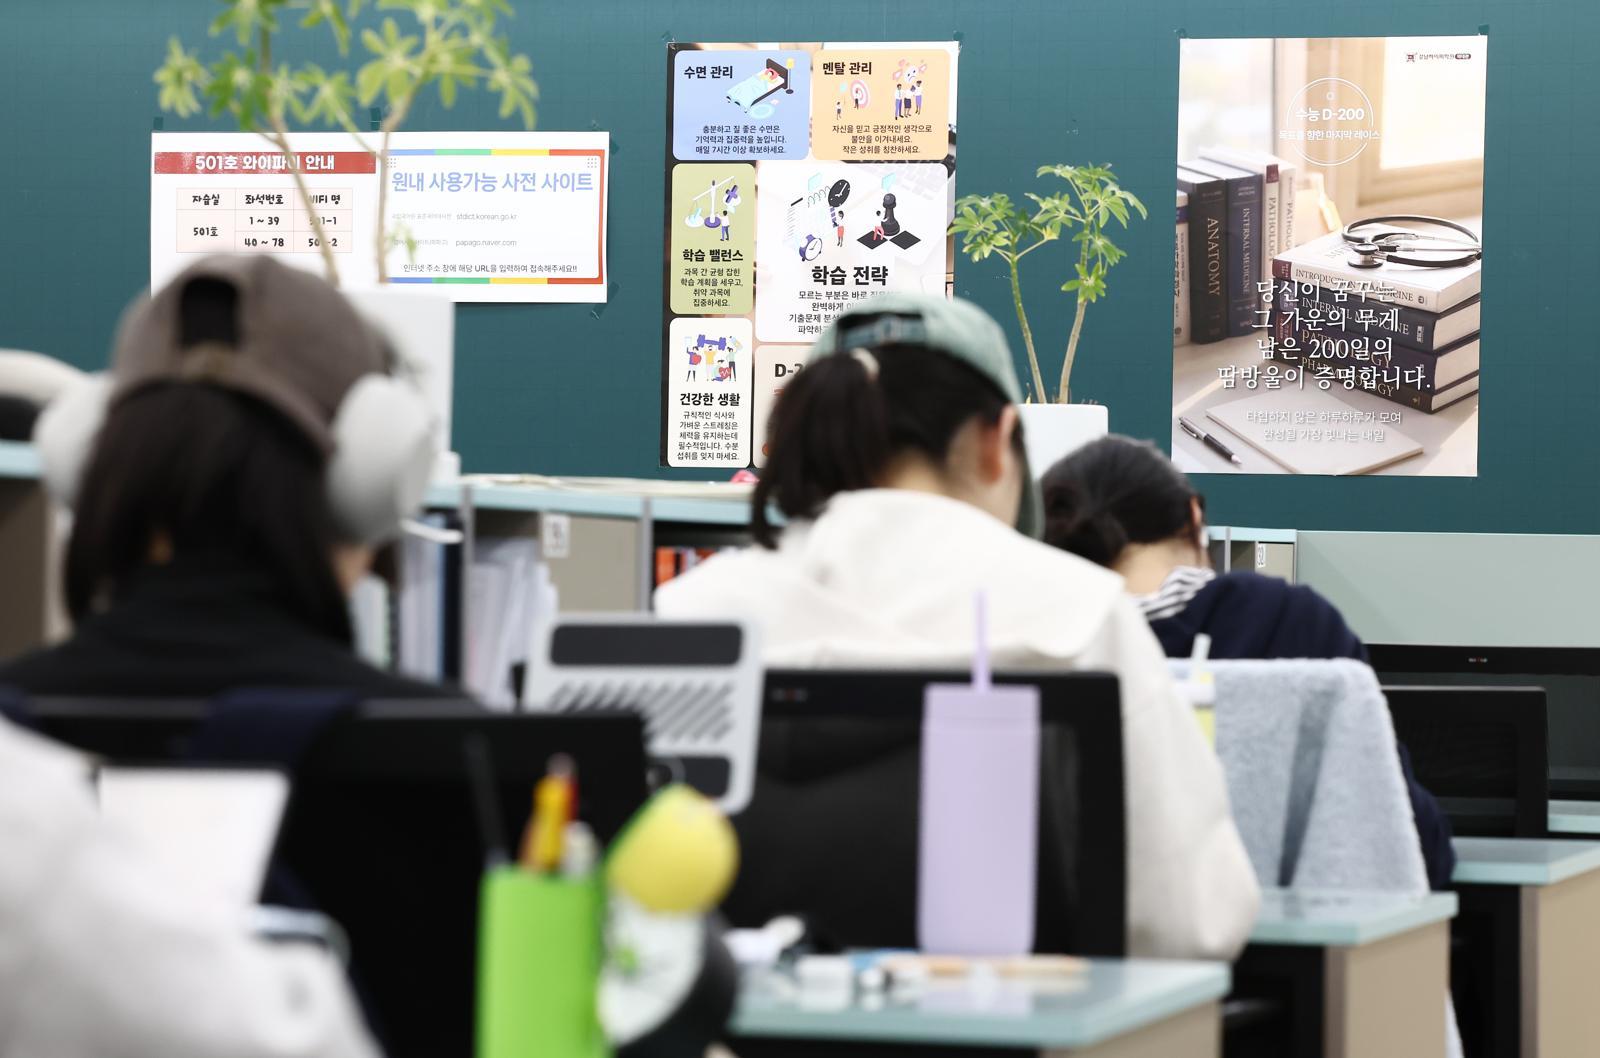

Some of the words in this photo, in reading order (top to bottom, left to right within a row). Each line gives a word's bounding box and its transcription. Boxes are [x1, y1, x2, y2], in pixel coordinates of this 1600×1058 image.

[684, 66, 707, 79] 수면
[710, 66, 733, 79] 관리
[822, 62, 846, 76] 멘탈
[849, 62, 872, 76] 관리
[1296, 107, 1320, 121] 수능
[1322, 108, 1364, 121] D-200
[702, 125, 732, 134] 충분하고
[733, 125, 740, 134] 질
[742, 125, 757, 134] 좋은
[758, 125, 780, 134] 수면은
[832, 124, 854, 134] 자신을
[856, 124, 870, 134] 믿고
[872, 124, 901, 134] 긍정적인
[903, 124, 932, 134] 생각으로
[695, 135, 724, 144] 기억력과
[726, 135, 754, 144] 집중력을
[851, 135, 872, 144] 불안을
[696, 146, 710, 154] 매일
[712, 146, 730, 154] 7시간
[732, 146, 747, 154] 이상
[842, 146, 858, 154] 작은
[859, 146, 881, 154] 성취를
[195, 155, 238, 170] 501호
[306, 155, 335, 170] 안내
[392, 172, 424, 192] 원내
[429, 172, 498, 192] 사용가능
[502, 172, 536, 192] 사전
[541, 172, 594, 192] 사이트
[192, 194, 220, 206] 자습실
[244, 194, 284, 205] 좌석번호
[331, 194, 341, 205] 명
[249, 217, 254, 225] 1
[268, 216, 280, 225] 39
[309, 216, 337, 226] 1-1
[193, 226, 219, 237] 501호
[1242, 207, 1250, 251] INTERNAL
[245, 238, 258, 247] 40
[272, 238, 285, 247] 78
[308, 238, 338, 247] 50-2
[455, 239, 517, 248] papago.naver.com
[682, 248, 706, 262] 학습
[709, 248, 744, 262] 밸런스
[1207, 218, 1220, 295] ANATOMY
[403, 264, 424, 273] 인터넷
[426, 264, 440, 273] 주소
[442, 264, 457, 273] 창에
[458, 264, 473, 273] 해당
[474, 264, 497, 273] URL을
[499, 264, 528, 273] 입력하여
[684, 268, 698, 276] 과목
[700, 268, 708, 276] 간
[710, 268, 724, 276] 균형
[726, 268, 740, 276] 잡힌
[811, 266, 847, 286] 학습
[853, 266, 888, 286] 전략
[680, 278, 695, 286] 학습
[696, 278, 718, 286] 계획을
[693, 288, 707, 297] 취약
[709, 288, 731, 297] 과목에
[798, 290, 823, 300] 모르는
[825, 290, 849, 300] 부분은
[851, 290, 868, 300] 바로
[1256, 279, 1320, 304] 당신이
[1330, 279, 1397, 304] 꿈꾸는
[812, 302, 844, 312] 완벽하게
[789, 314, 821, 323] 기출문제
[1251, 307, 1273, 332] 그
[1282, 307, 1346, 332] 가운의
[1354, 307, 1400, 332] 무게
[798, 325, 824, 334] 파악하
[1256, 336, 1301, 360] 남은
[1308, 336, 1393, 360] 200일의
[1217, 364, 1305, 390] 땀방울이
[1312, 364, 1431, 390] 증명합니다.
[680, 392, 714, 406] 건강한
[718, 392, 740, 406] 생활
[683, 411, 712, 420] 규칙적인
[714, 411, 735, 420] 식사와
[1246, 410, 1290, 424] 타협하지
[1294, 410, 1316, 424] 않은
[1320, 410, 1376, 424] 하루하루가
[1378, 410, 1401, 424] 모여
[679, 421, 701, 430] 가벼운
[702, 421, 738, 430] 스트레칭은
[679, 431, 700, 440] 체력을
[702, 431, 738, 440] 유지하는데
[1300, 428, 1321, 442] 가장
[1361, 428, 1385, 442] 내일
[724, 441, 738, 450] 수분
[677, 452, 698, 460] 섭취를
[700, 452, 714, 460] 잊지
